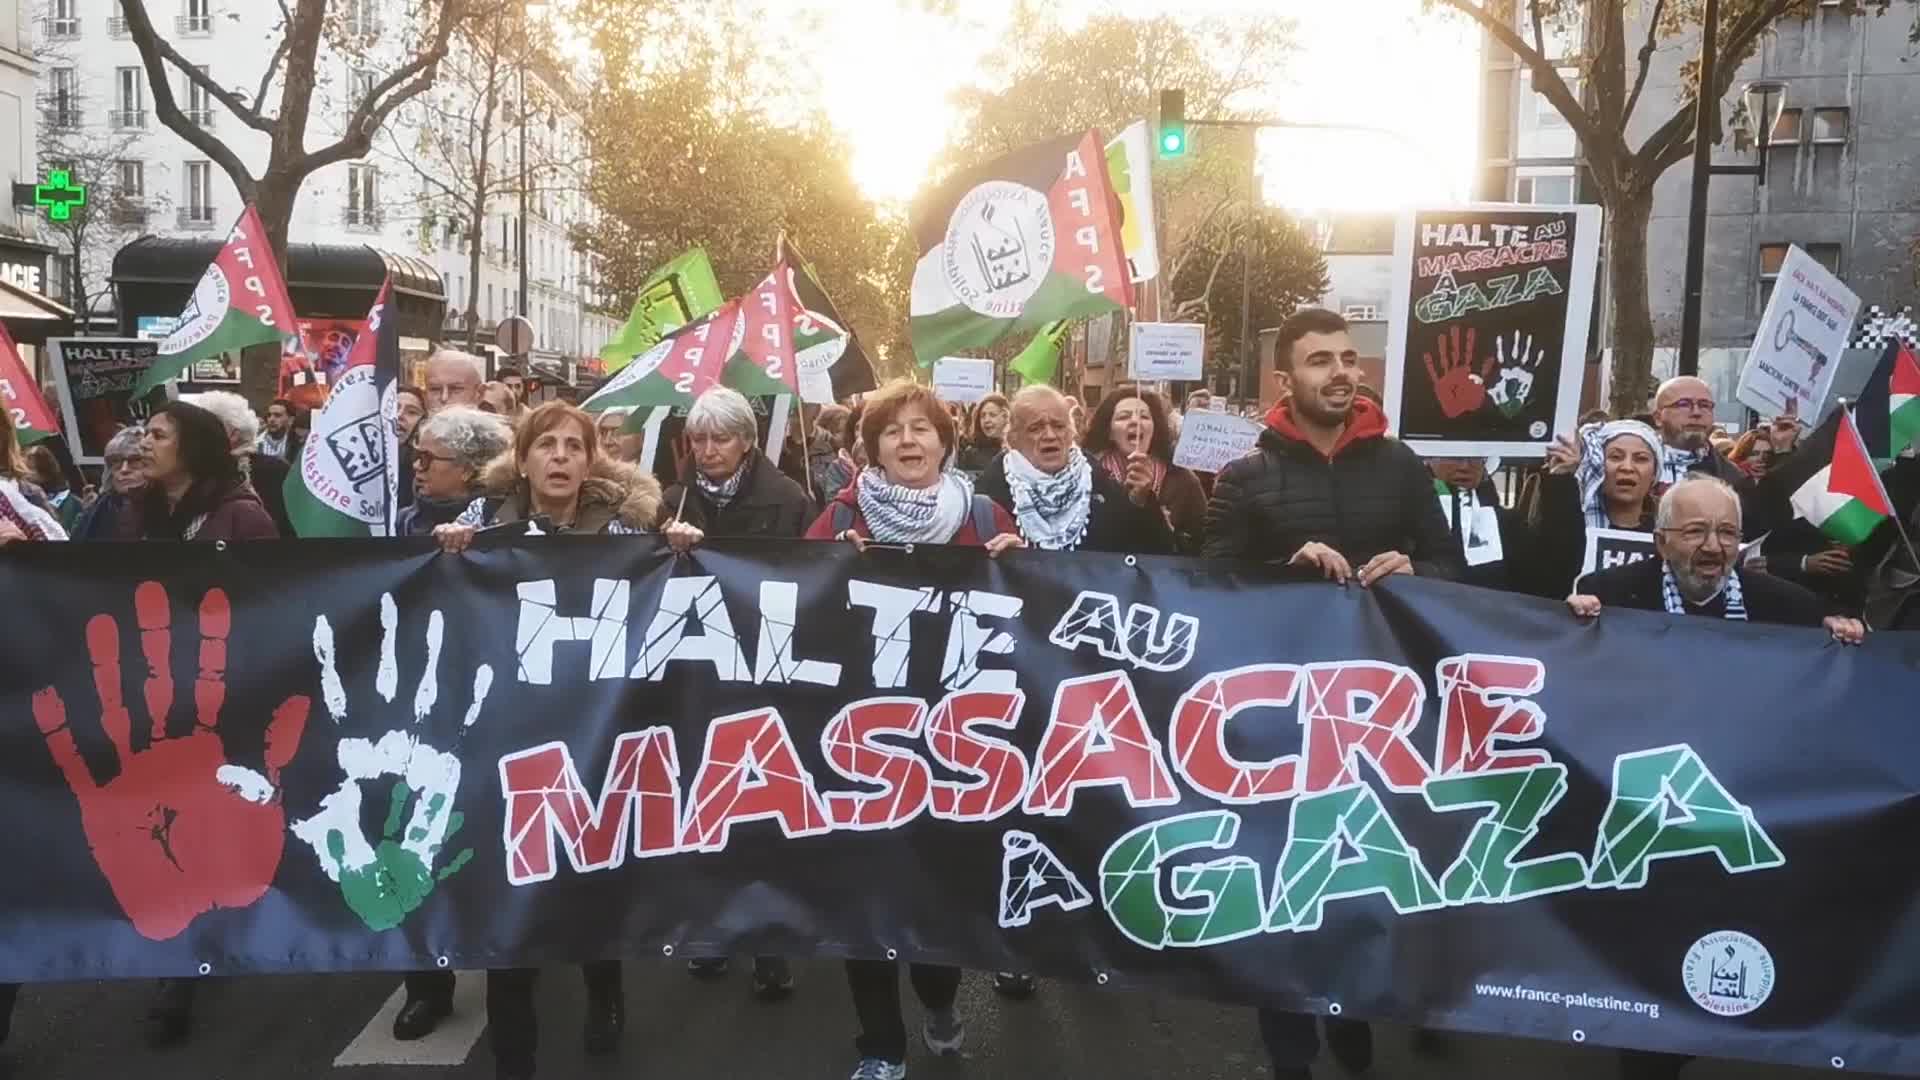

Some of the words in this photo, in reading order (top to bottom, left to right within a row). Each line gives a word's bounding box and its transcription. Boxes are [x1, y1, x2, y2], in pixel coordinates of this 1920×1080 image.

[1421, 223, 1529, 248] HALTE
[1534, 220, 1567, 241] AU
[1417, 238, 1568, 278] MASSACRE
[1414, 266, 1564, 324] GAZA
[65, 346, 131, 361] HALTE
[1602, 550, 1656, 570] HA
[515, 575, 1024, 690] HALTE
[1049, 590, 1200, 671] AU
[498, 653, 1553, 886] MASSACRE
[999, 830, 1093, 928] À
[1099, 743, 1786, 951] GAZA
[1475, 981, 1661, 1019] www.france-palestine.org
